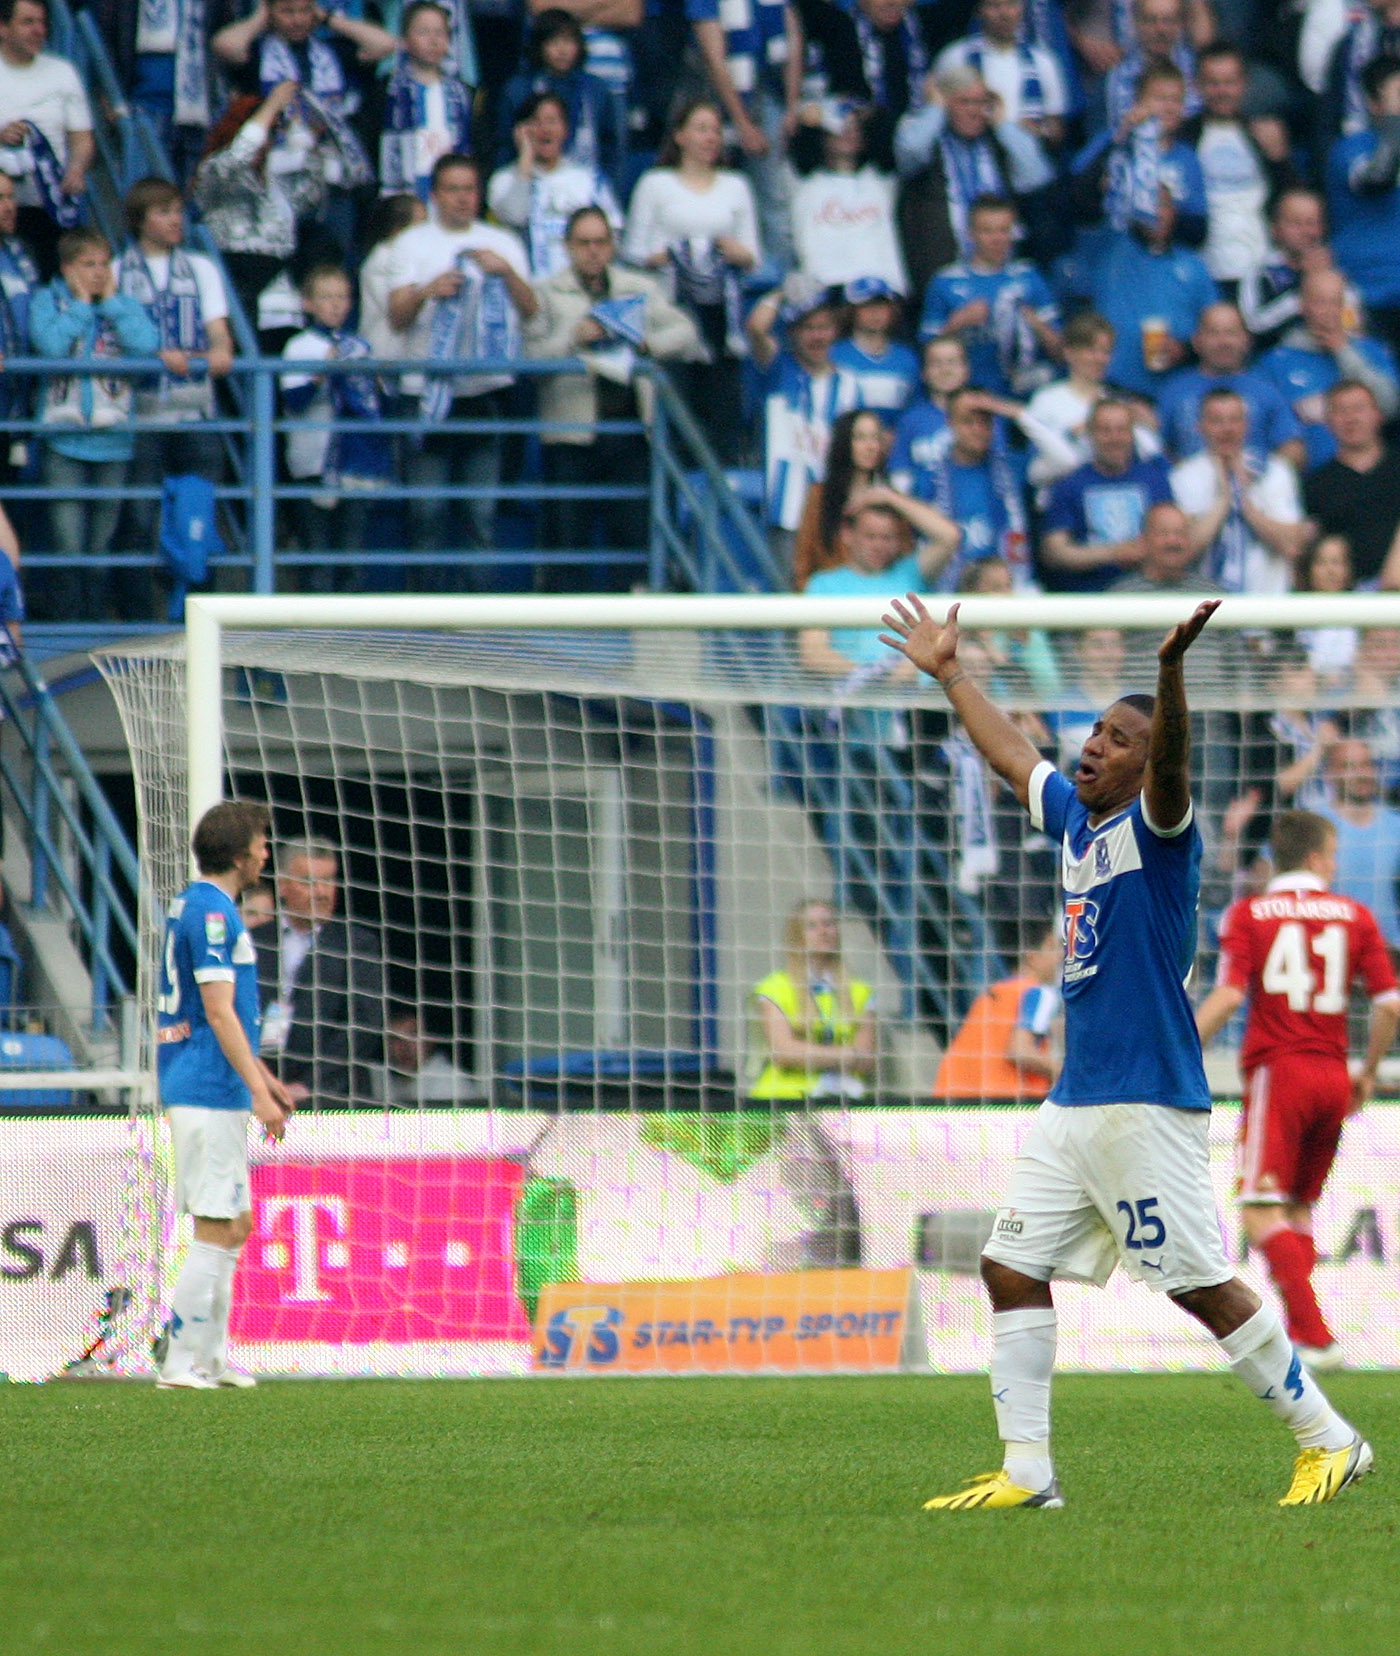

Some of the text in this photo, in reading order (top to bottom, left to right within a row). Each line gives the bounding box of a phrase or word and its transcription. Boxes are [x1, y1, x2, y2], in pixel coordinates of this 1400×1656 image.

[1262, 923, 1348, 1014] 41
[1116, 1197, 1166, 1249] 25
[537, 1305, 900, 1371] STS STAR-TYP SPORT
